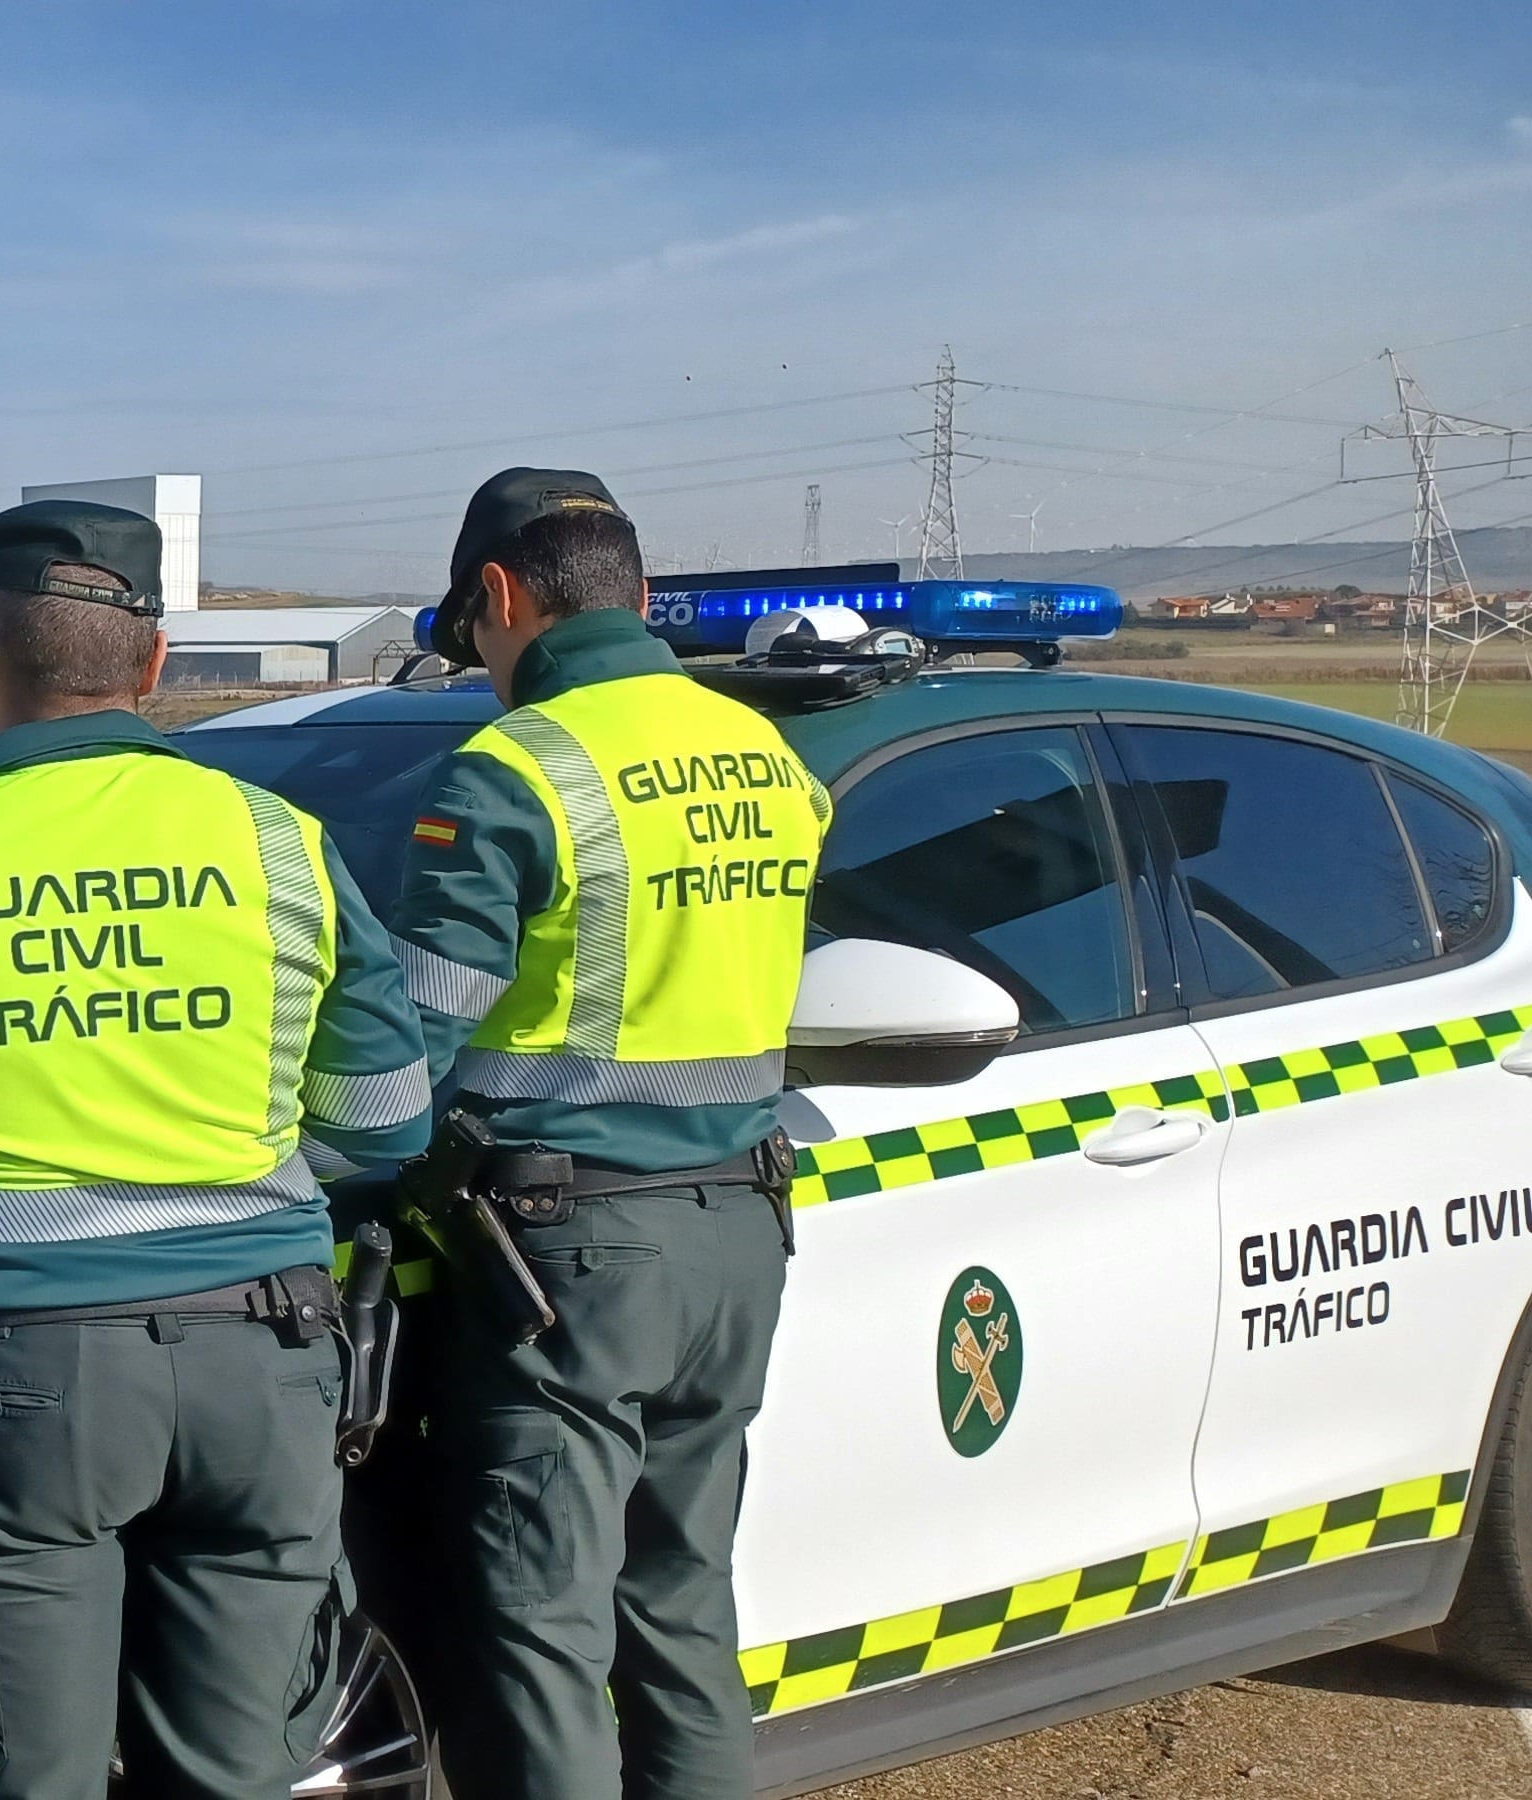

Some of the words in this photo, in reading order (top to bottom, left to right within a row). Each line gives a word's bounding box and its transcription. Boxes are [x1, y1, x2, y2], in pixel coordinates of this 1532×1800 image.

[646, 603, 694, 627] CO
[648, 592, 692, 602] CIVIL
[618, 752, 805, 804] GUARDIA
[685, 801, 773, 844] CIVIL
[11, 924, 163, 975] CIVIL
[1240, 1206, 1429, 1287] GUARDIA
[1241, 1281, 1390, 1351] TRÁFICO
